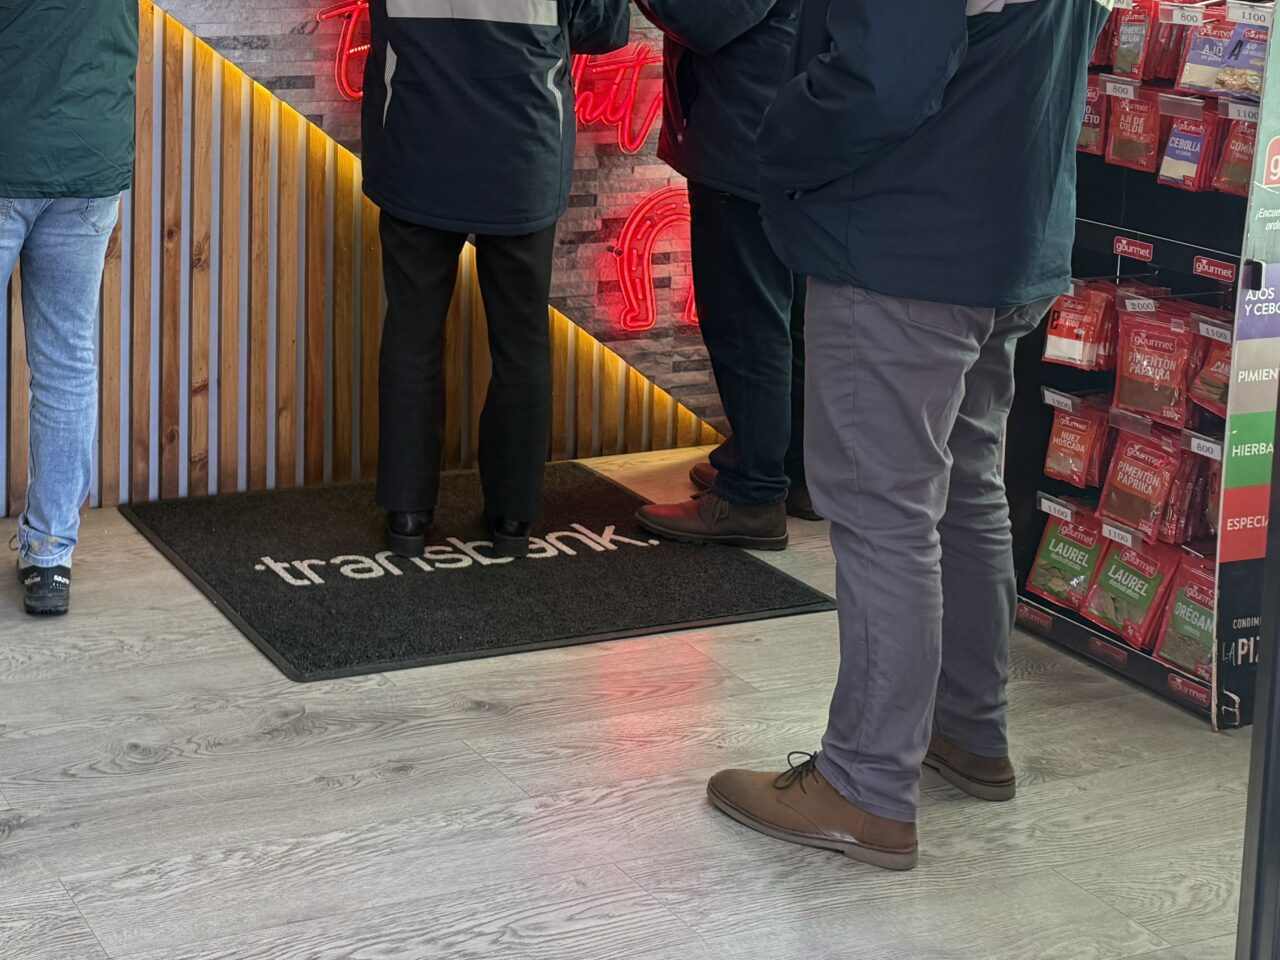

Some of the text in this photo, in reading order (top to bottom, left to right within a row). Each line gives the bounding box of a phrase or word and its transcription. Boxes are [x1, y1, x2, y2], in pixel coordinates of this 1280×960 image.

[1200, 26, 1234, 38] gourmet
[1120, 123, 1144, 133] COLOR
[1133, 117, 1145, 125] DE
[1169, 137, 1201, 152] CEBOLLA
[1231, 140, 1255, 155] COMIN
[1255, 208, 1280, 220] ¡Encue
[1116, 241, 1151, 257] gourmet
[1195, 261, 1233, 278] gourmet
[1245, 288, 1275, 302] AJOS
[1244, 305, 1253, 316] Y
[1134, 334, 1174, 350] gourmet
[1238, 368, 1279, 383] PIMIEN
[1060, 417, 1088, 431] gourmet
[1061, 431, 1080, 442] NUEZ
[1053, 436, 1085, 453] MOSCADA
[1232, 442, 1275, 457] HIERBA
[1127, 446, 1162, 467] gourmet
[1117, 472, 1153, 496] PAPRIKA
[1227, 516, 1270, 530] ESPECI
[1060, 525, 1093, 545] gourmet
[1048, 538, 1088, 567] LAUREL
[1122, 551, 1155, 575] gourmet
[1108, 565, 1149, 597] LAUREL
[1186, 586, 1215, 607] gourme
[1174, 602, 1214, 633] ORÉGAN
[1233, 616, 1261, 629] CONDIM
[1171, 680, 1207, 702] gourmet
